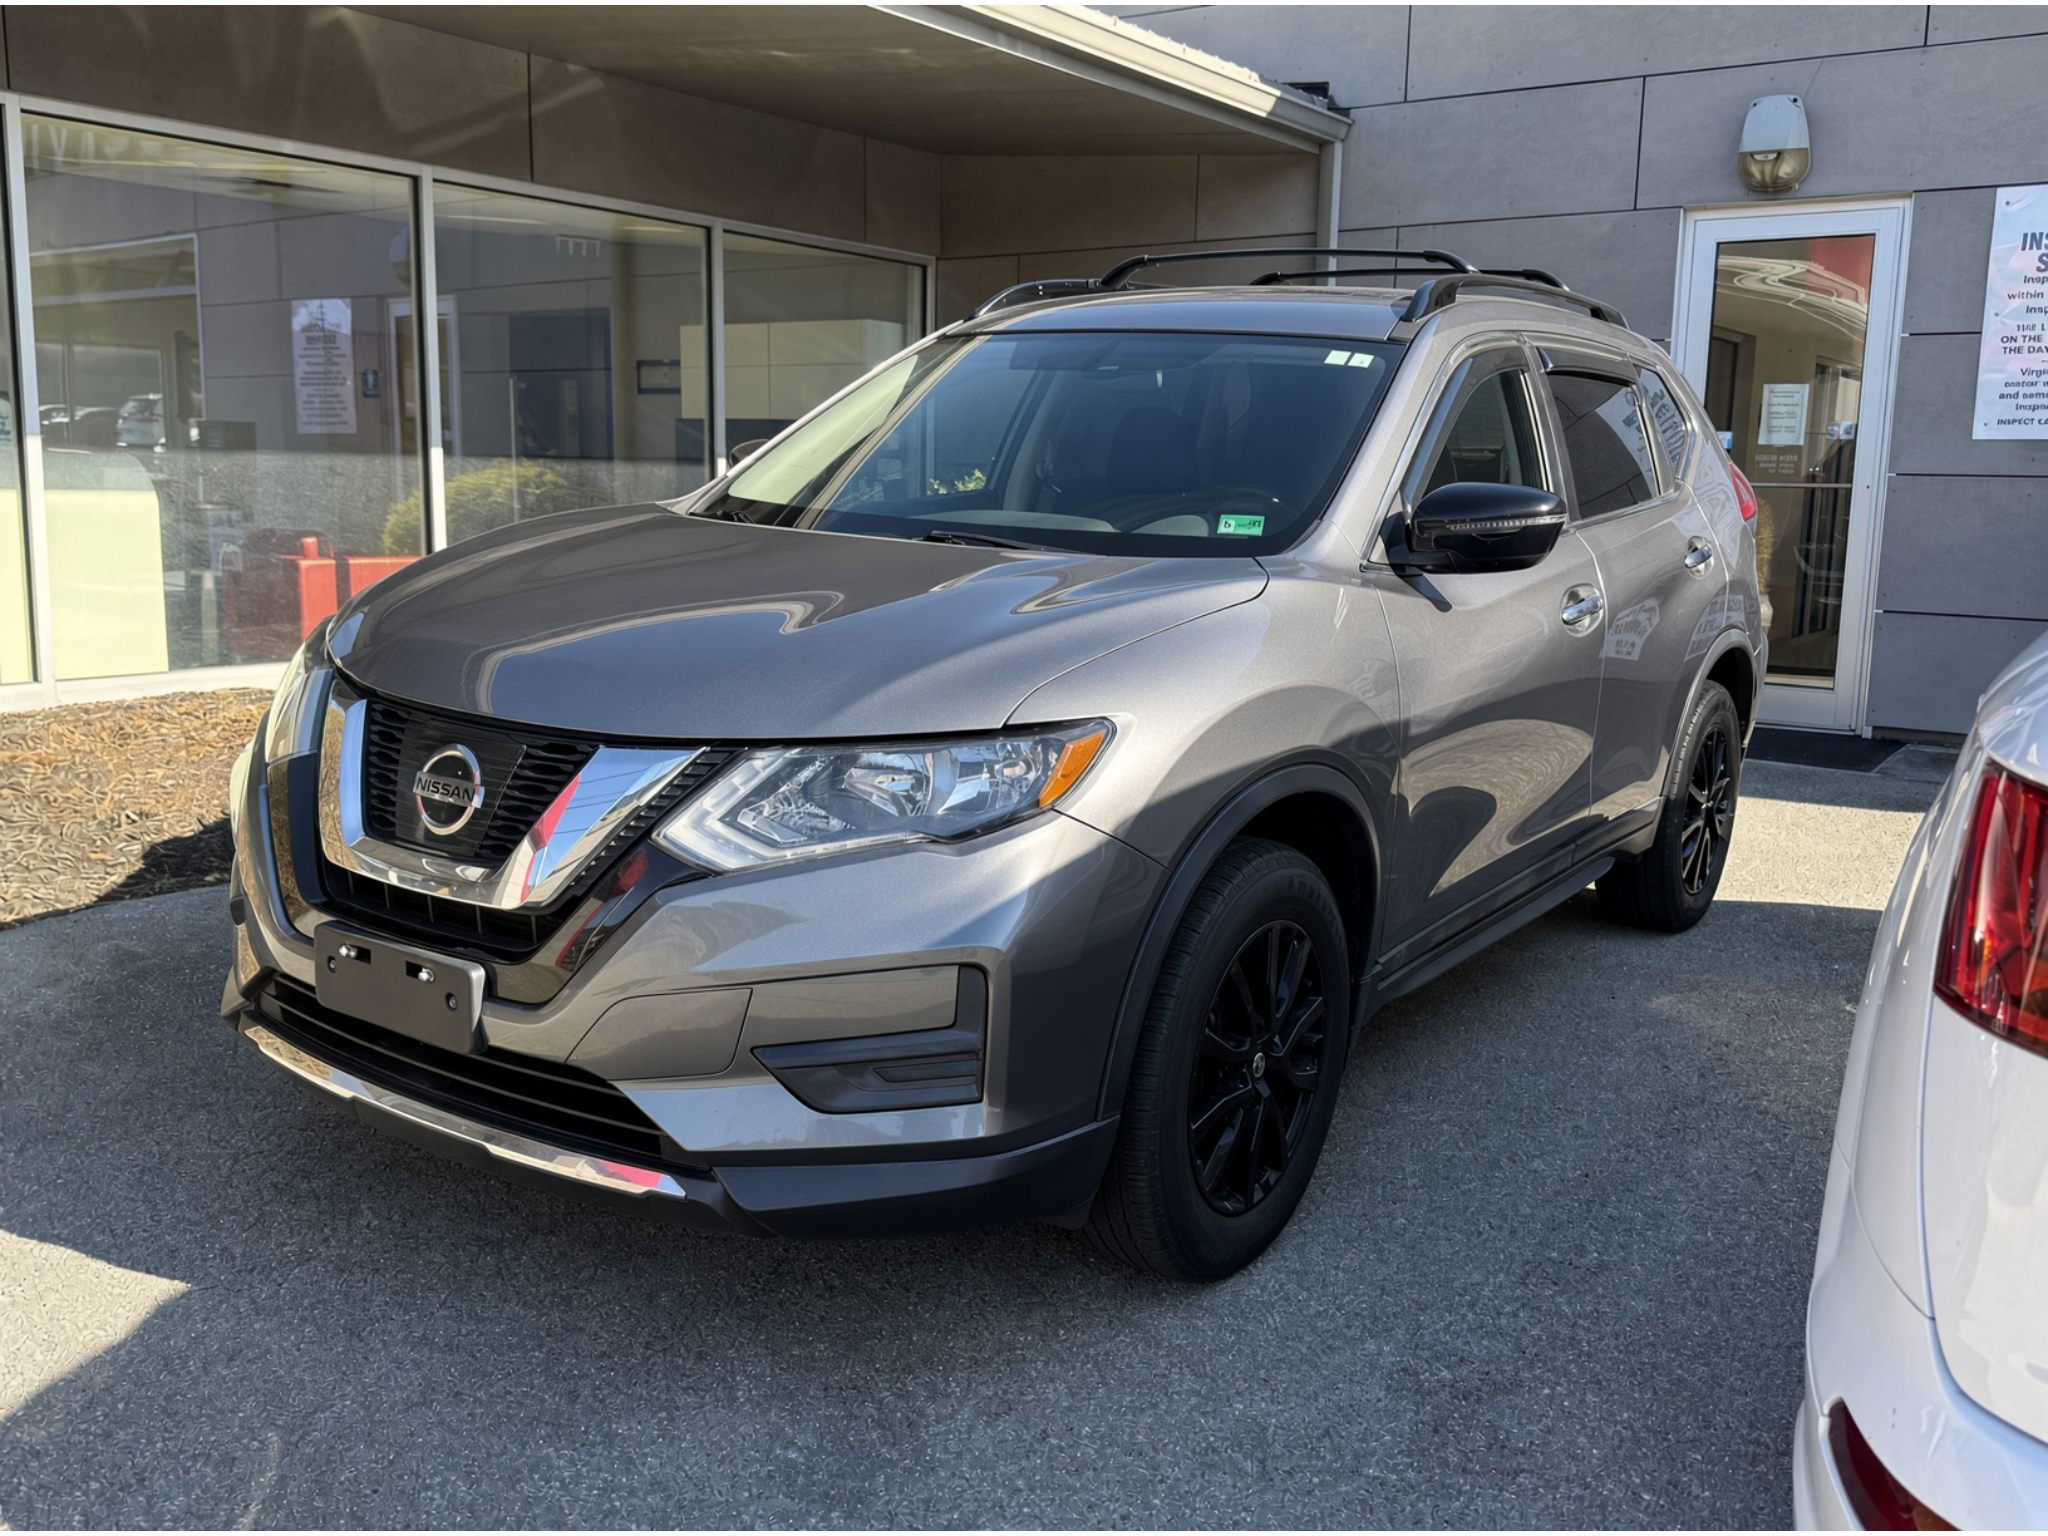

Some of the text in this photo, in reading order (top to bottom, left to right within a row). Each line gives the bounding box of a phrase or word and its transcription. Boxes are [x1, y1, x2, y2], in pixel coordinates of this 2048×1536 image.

[2007, 290, 2044, 300] within
[2000, 334, 2043, 344] ON THE
[2002, 345, 2024, 355] THE
[1999, 390, 2020, 400] and
[415, 777, 475, 801] NISSAN
